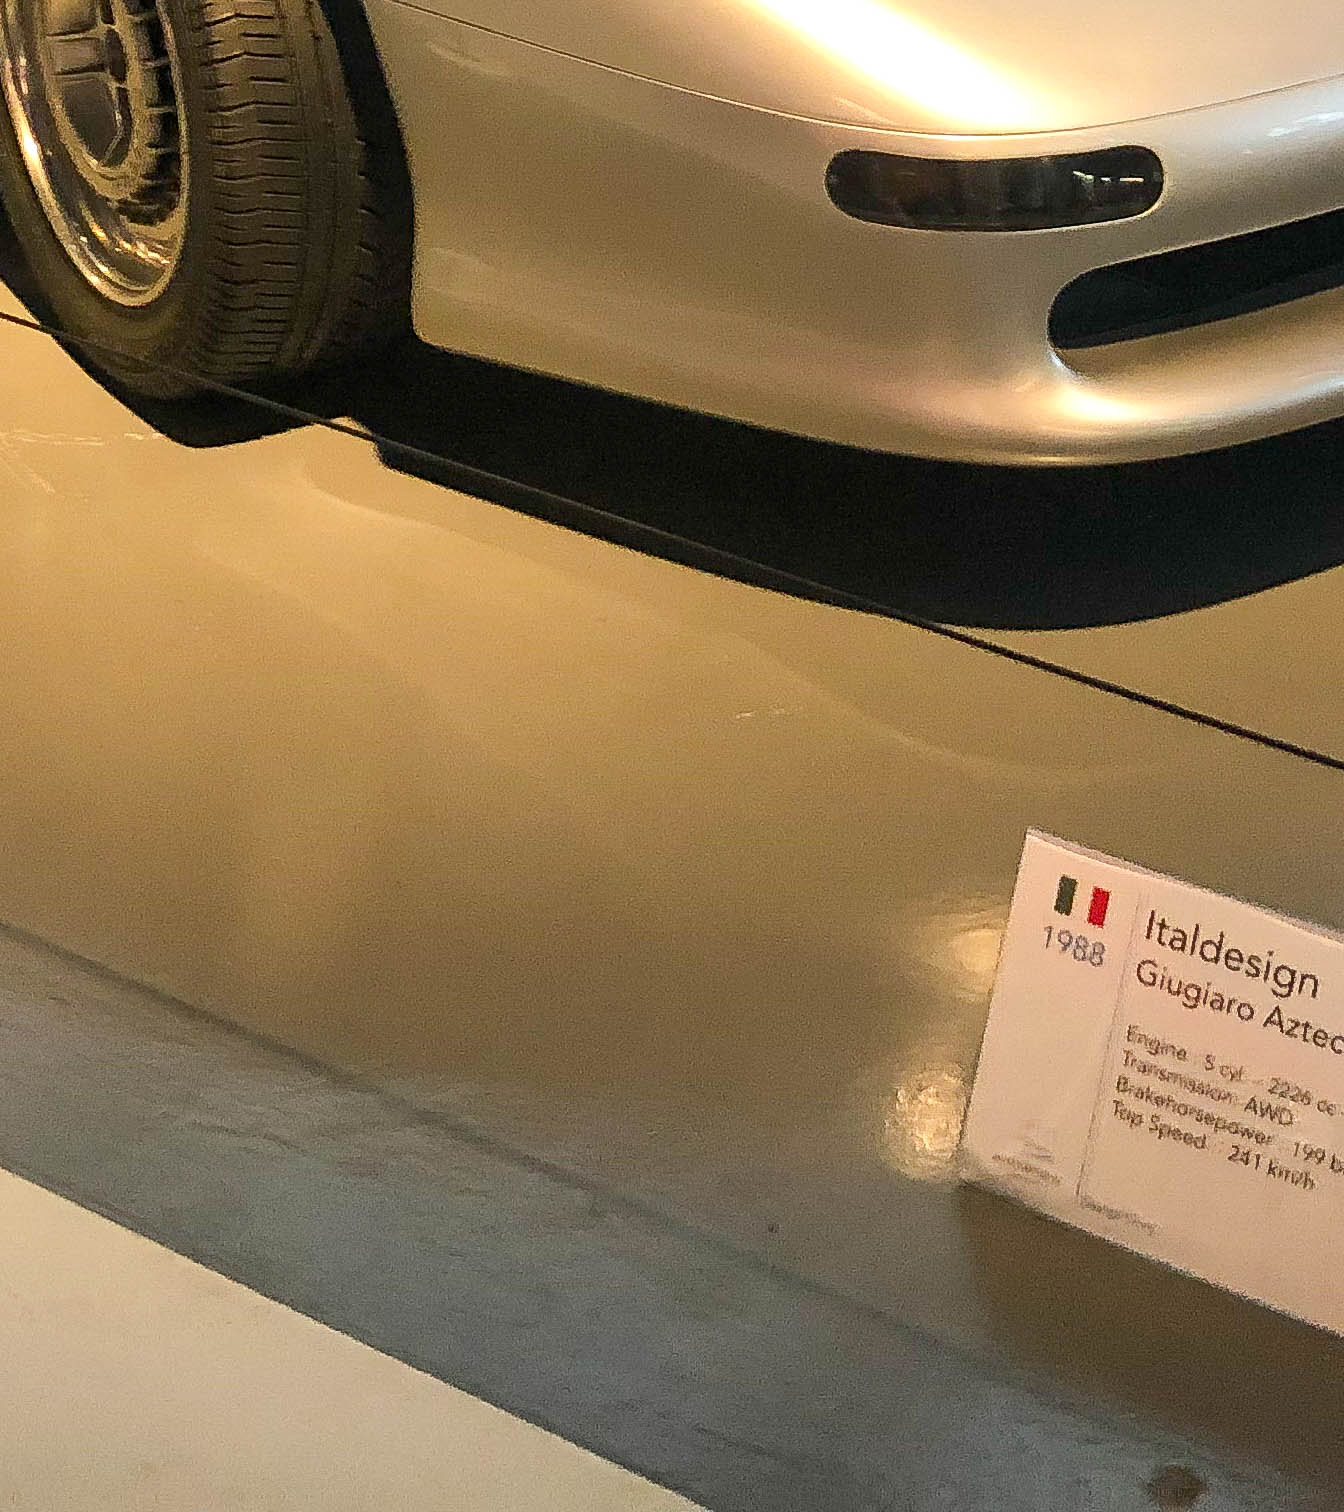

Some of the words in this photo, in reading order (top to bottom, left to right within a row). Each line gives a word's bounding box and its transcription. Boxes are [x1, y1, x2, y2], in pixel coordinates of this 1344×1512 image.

[1043, 925, 1106, 968] 1988
[1144, 909, 1321, 1000] Italdesign
[1135, 958, 1256, 1023] Giugiaro
[1112, 1098, 1145, 1129] Top
[1226, 1143, 1262, 1171] 241
[1243, 1094, 1296, 1127] AWD
